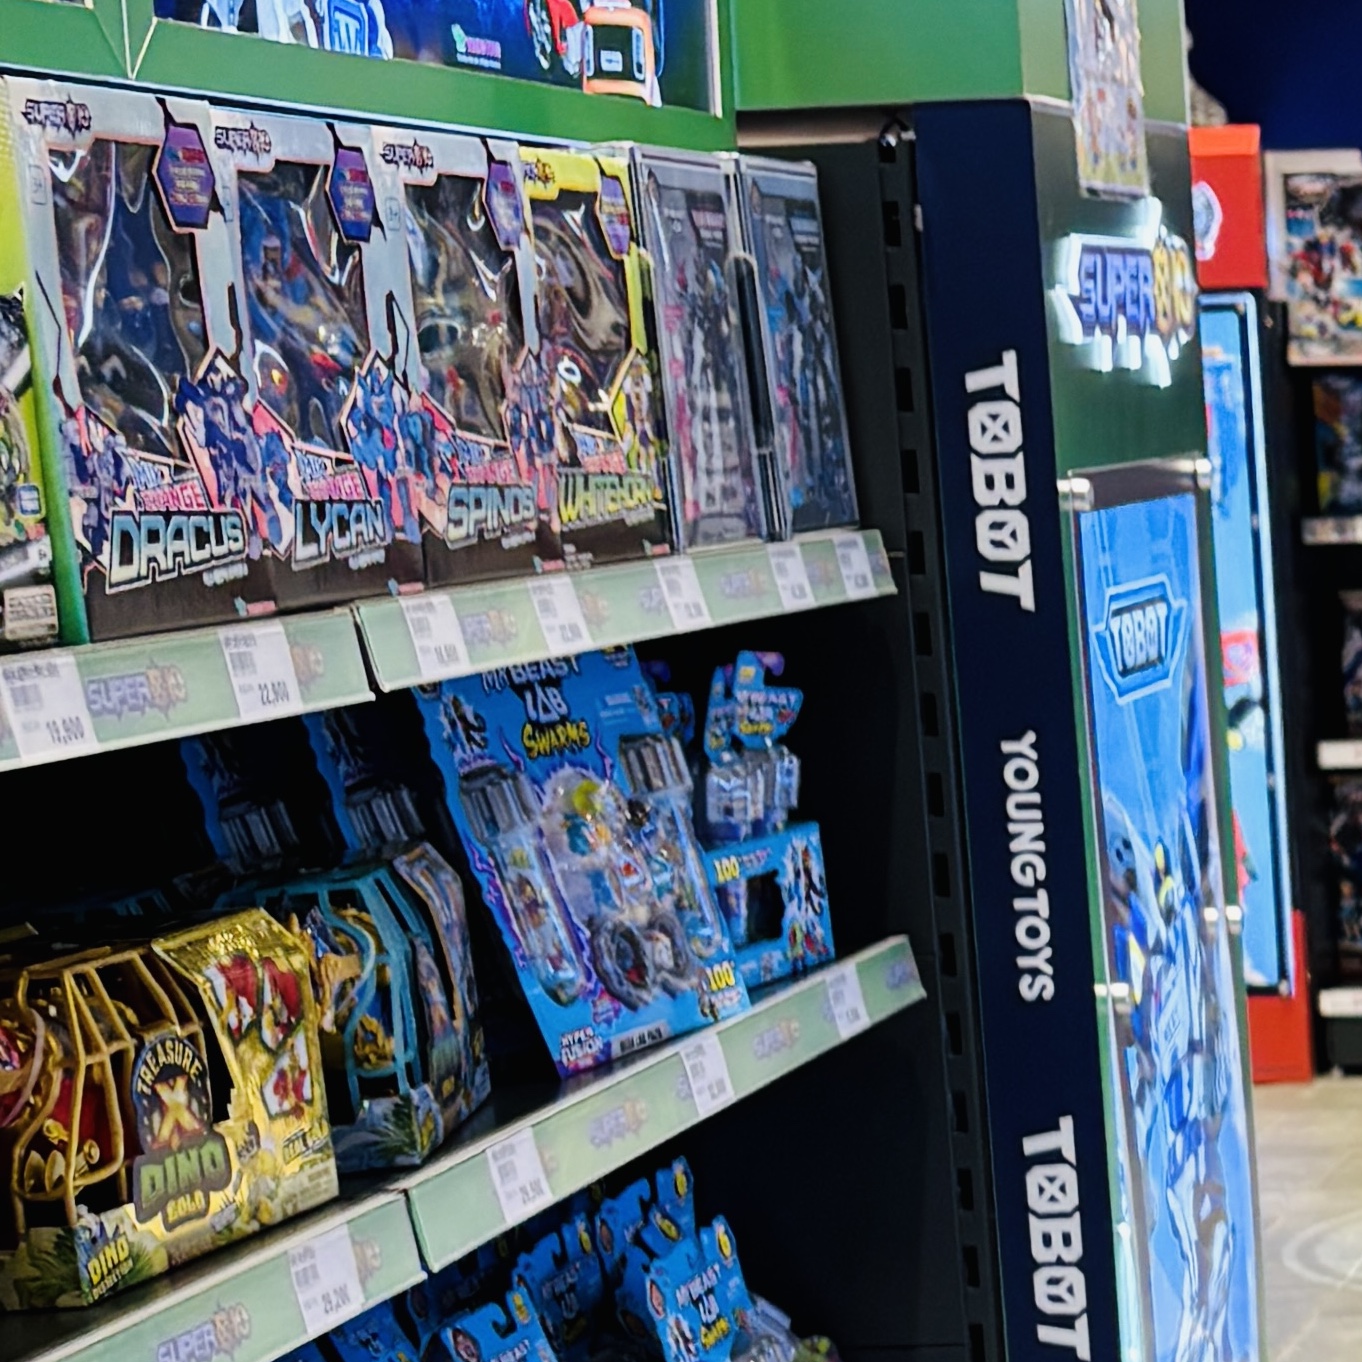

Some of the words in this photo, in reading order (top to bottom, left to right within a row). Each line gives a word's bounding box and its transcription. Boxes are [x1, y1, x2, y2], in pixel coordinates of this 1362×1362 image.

[964, 350, 1036, 612] TOBOT
[110, 513, 245, 584] DRACUS
[295, 500, 387, 561] LYCAN
[137, 1042, 203, 1096] TREASURE
[140, 1138, 226, 1209] DINO
[87, 1238, 130, 1286] DINO
[1022, 1115, 1092, 1362] TOBOT
